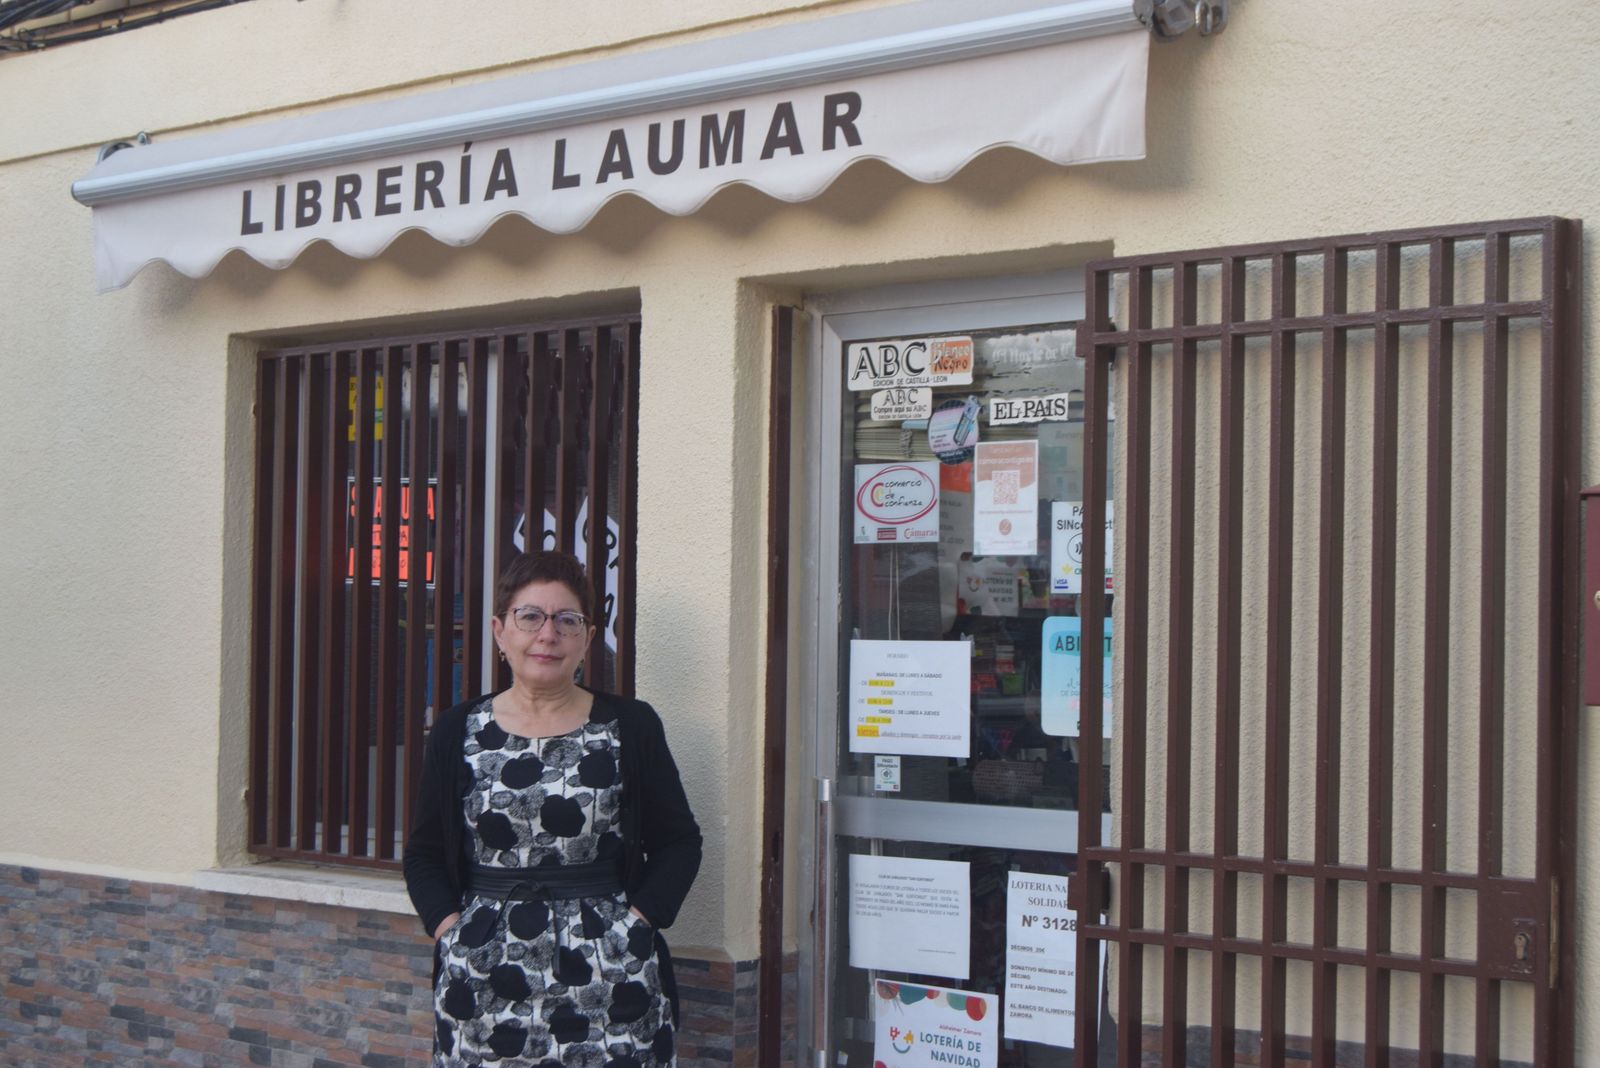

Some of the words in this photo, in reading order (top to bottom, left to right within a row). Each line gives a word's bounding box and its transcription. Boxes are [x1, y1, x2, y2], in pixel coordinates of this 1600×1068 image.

[241, 142, 518, 236] LIBRERÍA
[551, 91, 863, 190] LAUMAR
[851, 341, 927, 380] ABC
[883, 389, 918, 406] ABC
[994, 401, 1020, 420] EL
[1011, 880, 1053, 893] LOTERIA
[1042, 916, 1077, 932] 3128
[920, 1031, 964, 1051] LOTERÍA
[967, 1040, 981, 1053] DE
[930, 1049, 980, 1068] NAVIDAD
